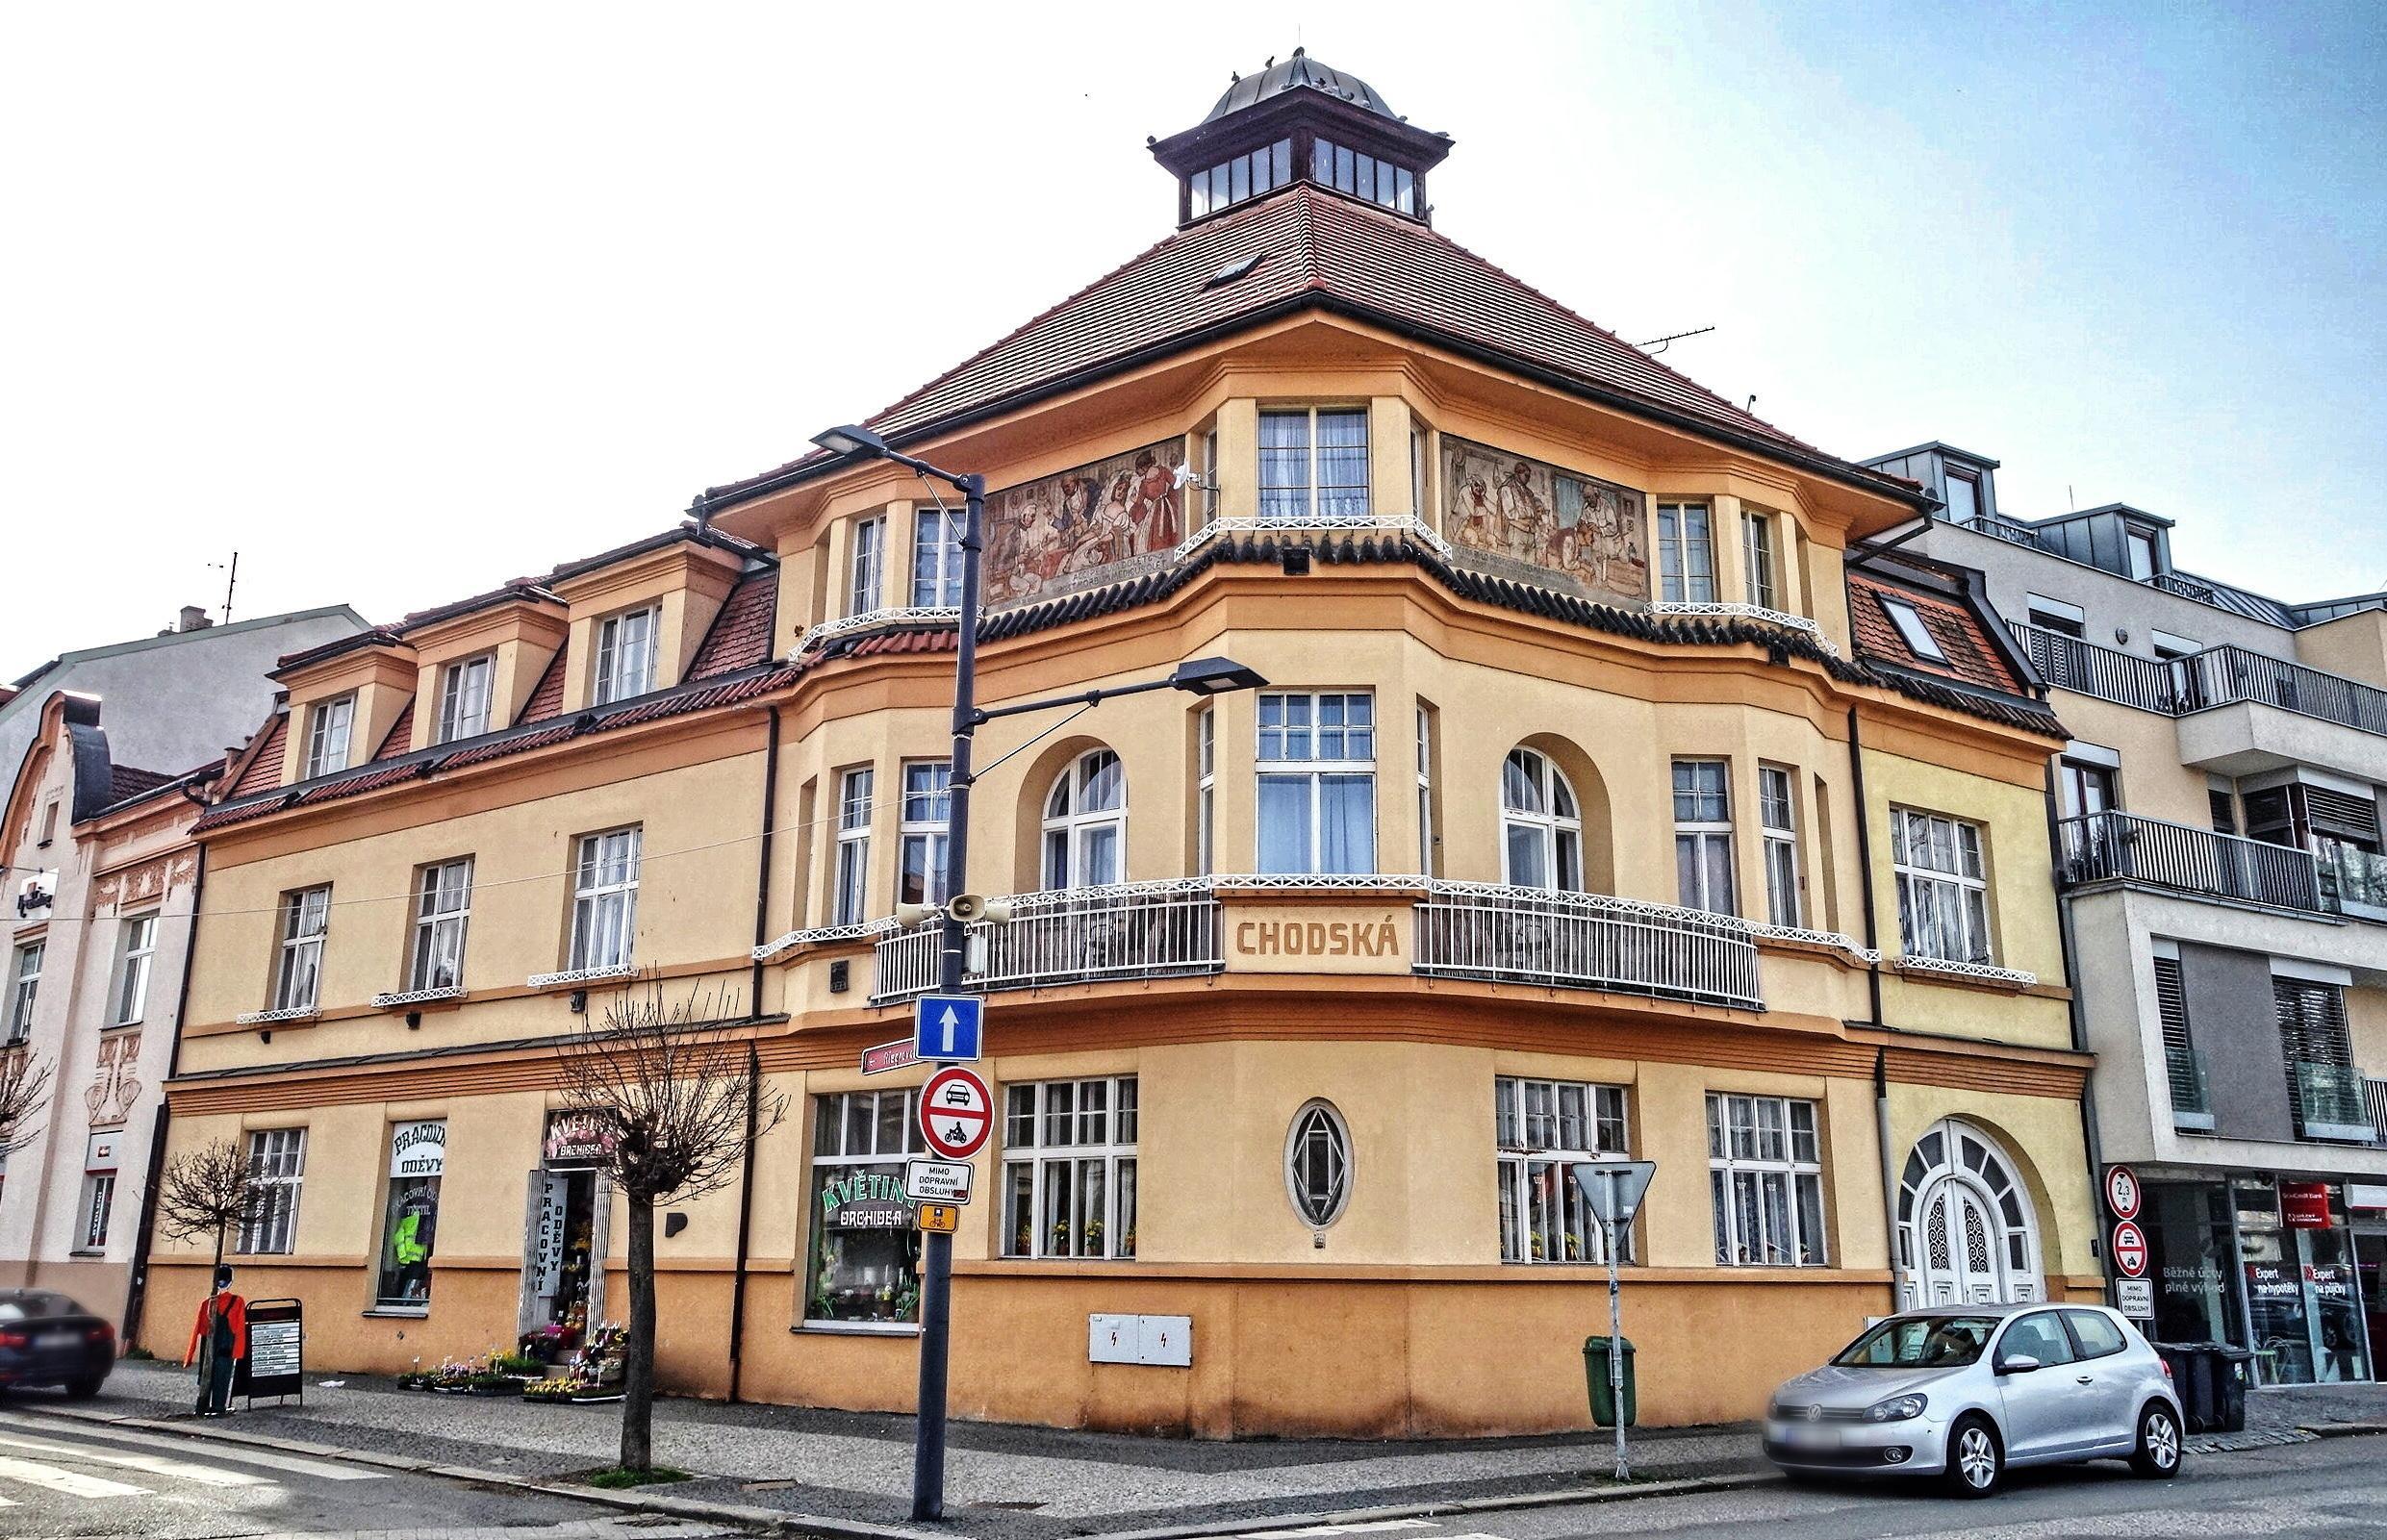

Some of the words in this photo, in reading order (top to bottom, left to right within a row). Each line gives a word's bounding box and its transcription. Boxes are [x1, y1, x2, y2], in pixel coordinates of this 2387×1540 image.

[1236, 915, 1399, 956] CHODSKÁ
[401, 1154, 443, 1174] ODĚVY
[928, 1167, 951, 1175] MIMO
[919, 1176, 959, 1186] DOPRAVNÍ
[822, 1169, 916, 1213] KVĚTIN
[919, 1186, 955, 1197] OBSLUHY
[840, 1210, 902, 1227] ORCHIDEA
[536, 1183, 554, 1291] PRACOVNÍ
[550, 1205, 564, 1272] ODĚVY
[2255, 1268, 2279, 1280] Expert
[2313, 1269, 2335, 1281] Expert
[2165, 1281, 2189, 1295] plné
[2257, 1284, 2268, 1293] na
[2315, 1284, 2324, 1293] na
